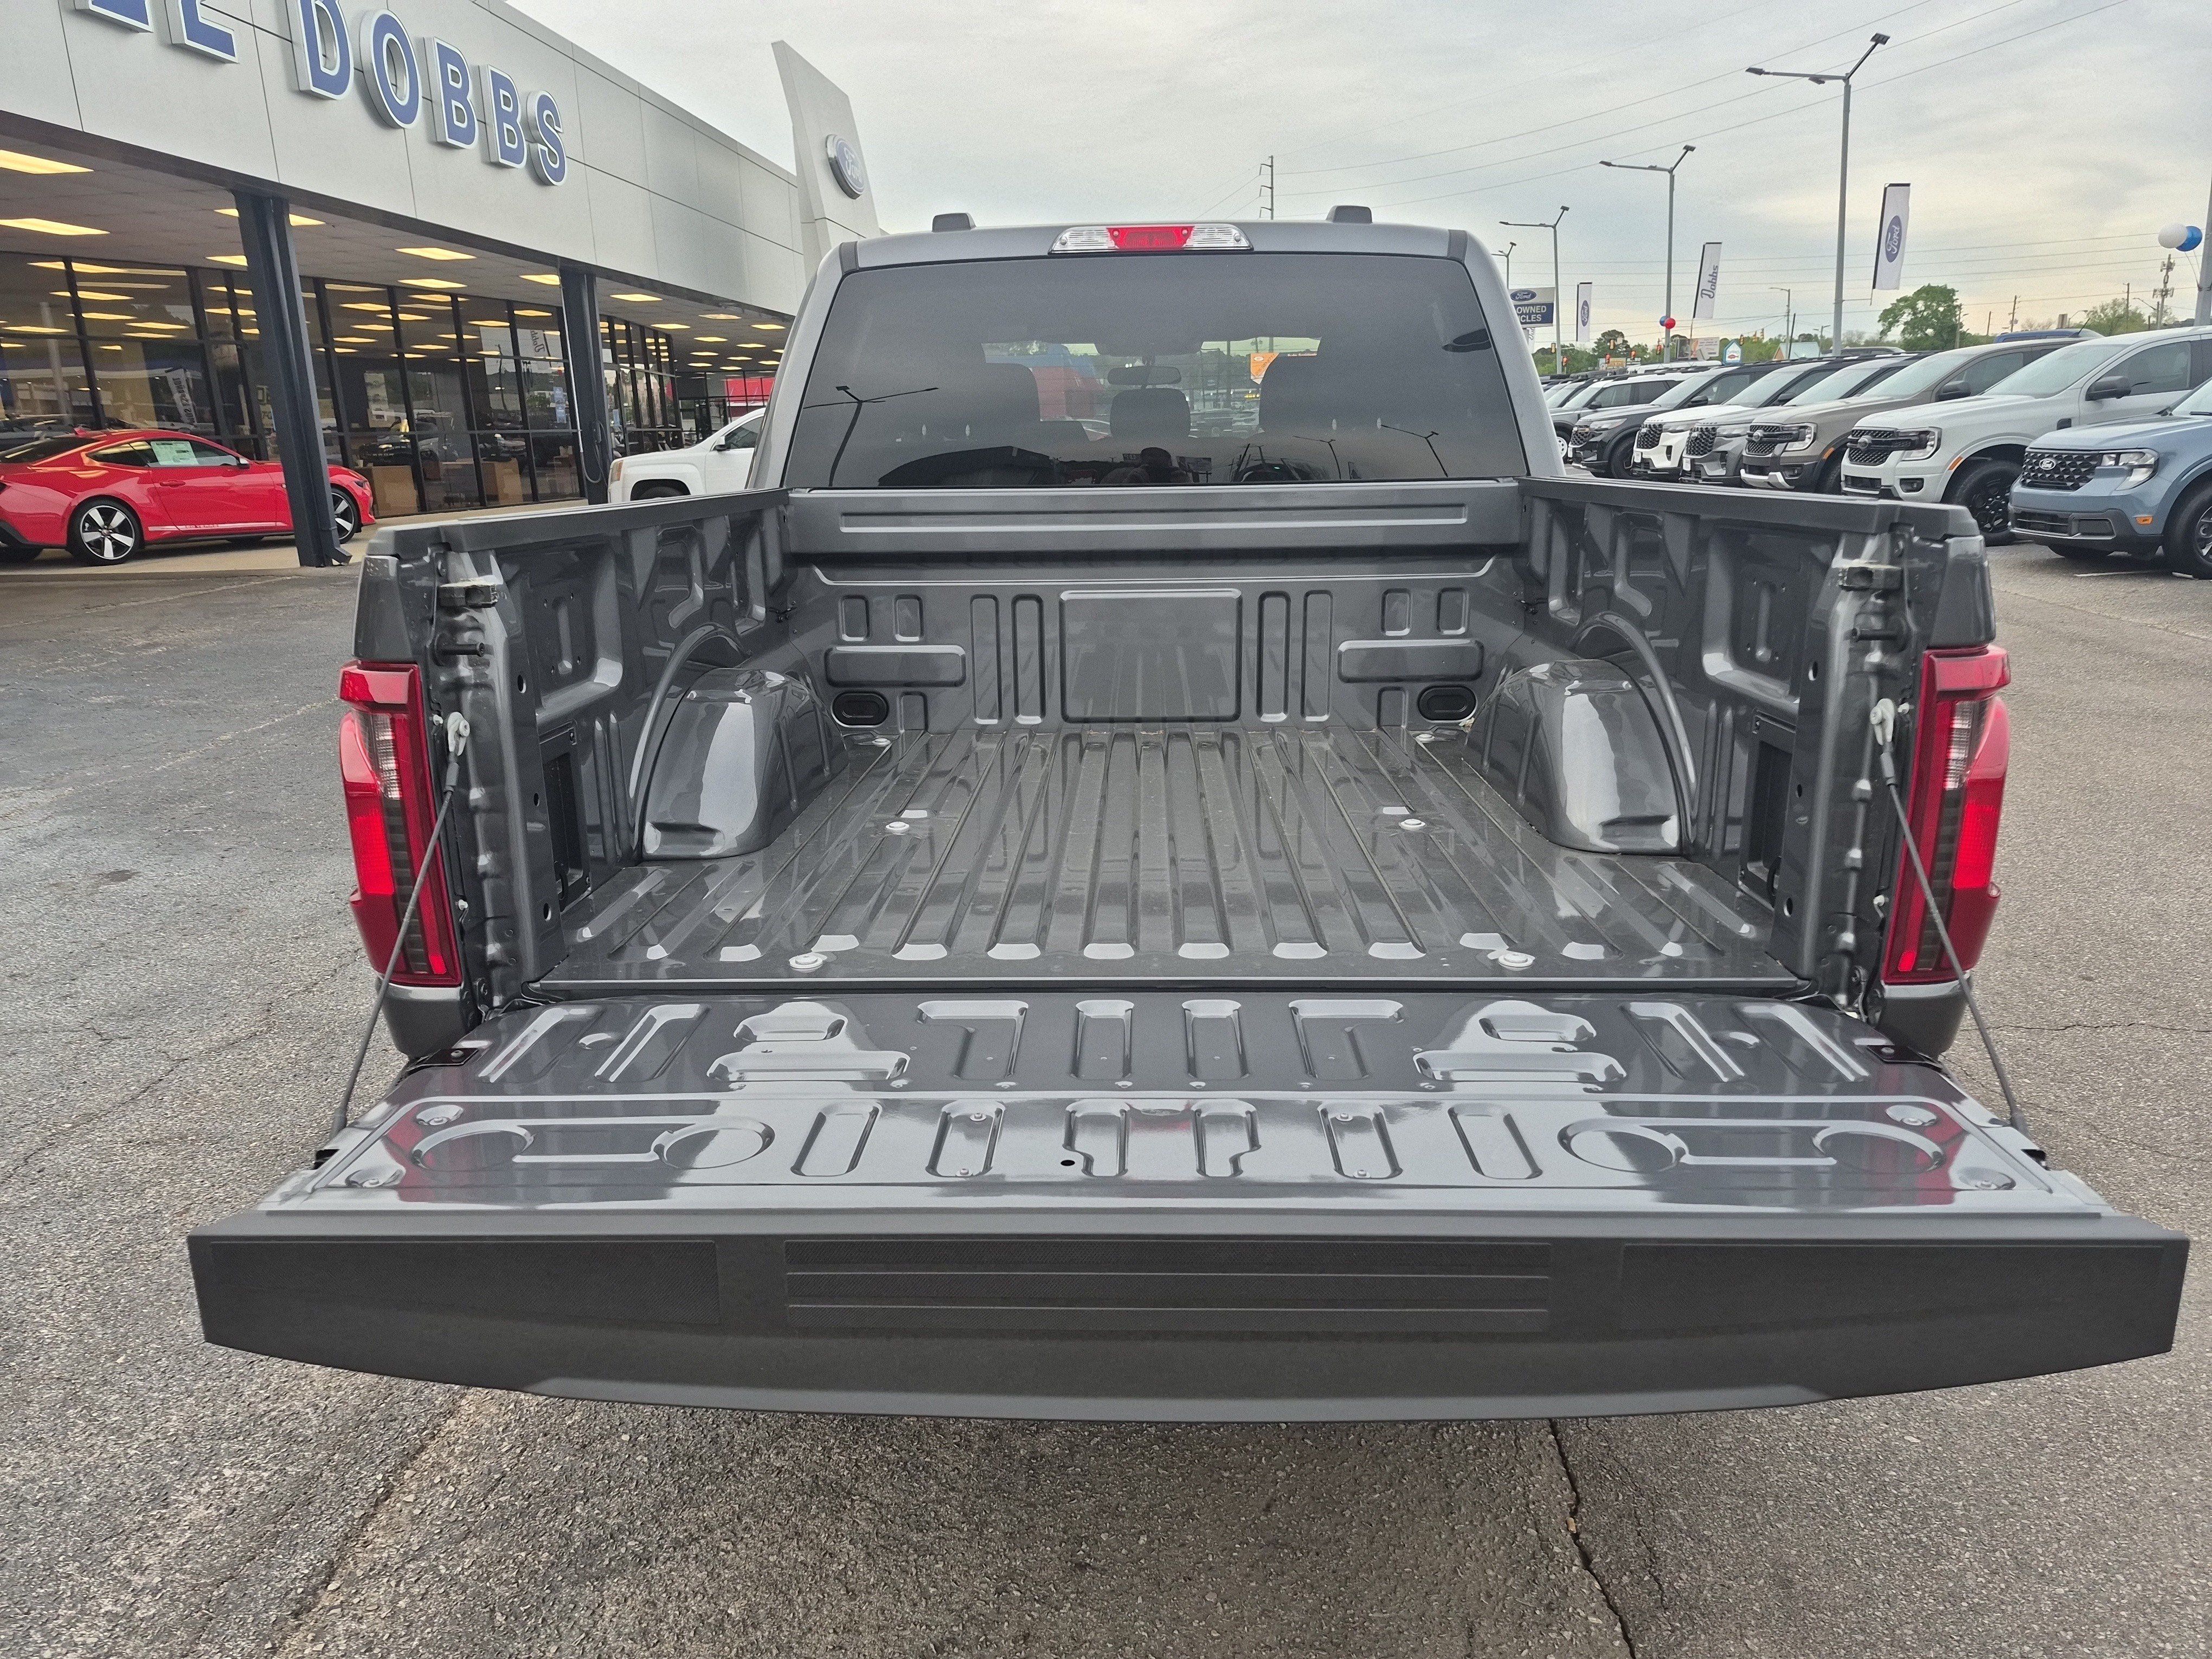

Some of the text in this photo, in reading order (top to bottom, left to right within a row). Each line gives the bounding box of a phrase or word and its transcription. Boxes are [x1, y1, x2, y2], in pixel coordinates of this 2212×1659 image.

[293, 0, 568, 185] DOBBS
[1887, 224, 1900, 254] Ford
[1515, 291, 1532, 300] Ford
[1700, 265, 1719, 299] Dobbs
[1516, 305, 1547, 314] OWNED
